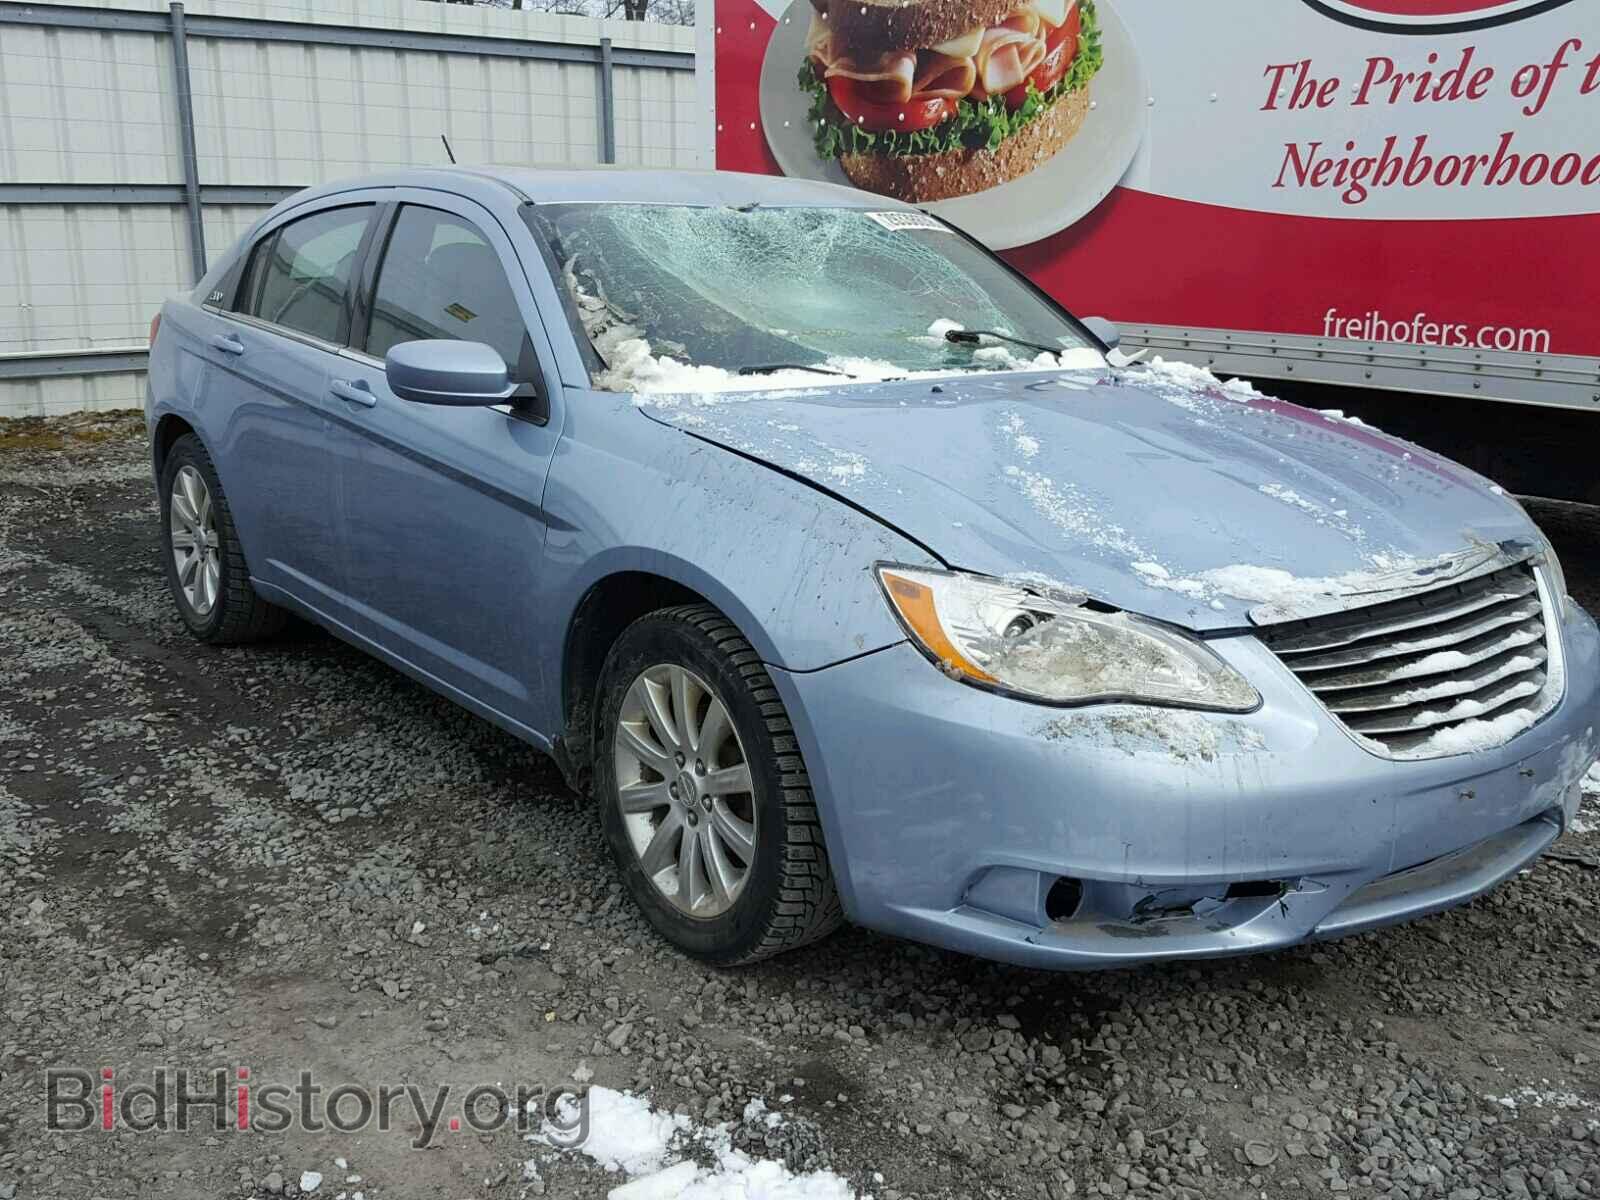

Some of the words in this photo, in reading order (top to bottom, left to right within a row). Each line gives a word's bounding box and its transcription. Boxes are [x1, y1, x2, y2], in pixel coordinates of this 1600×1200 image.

[1259, 59, 1340, 111] The
[1350, 46, 1494, 106] Pride
[1510, 38, 1582, 116] of
[1323, 308, 1550, 353] freihofers.com
